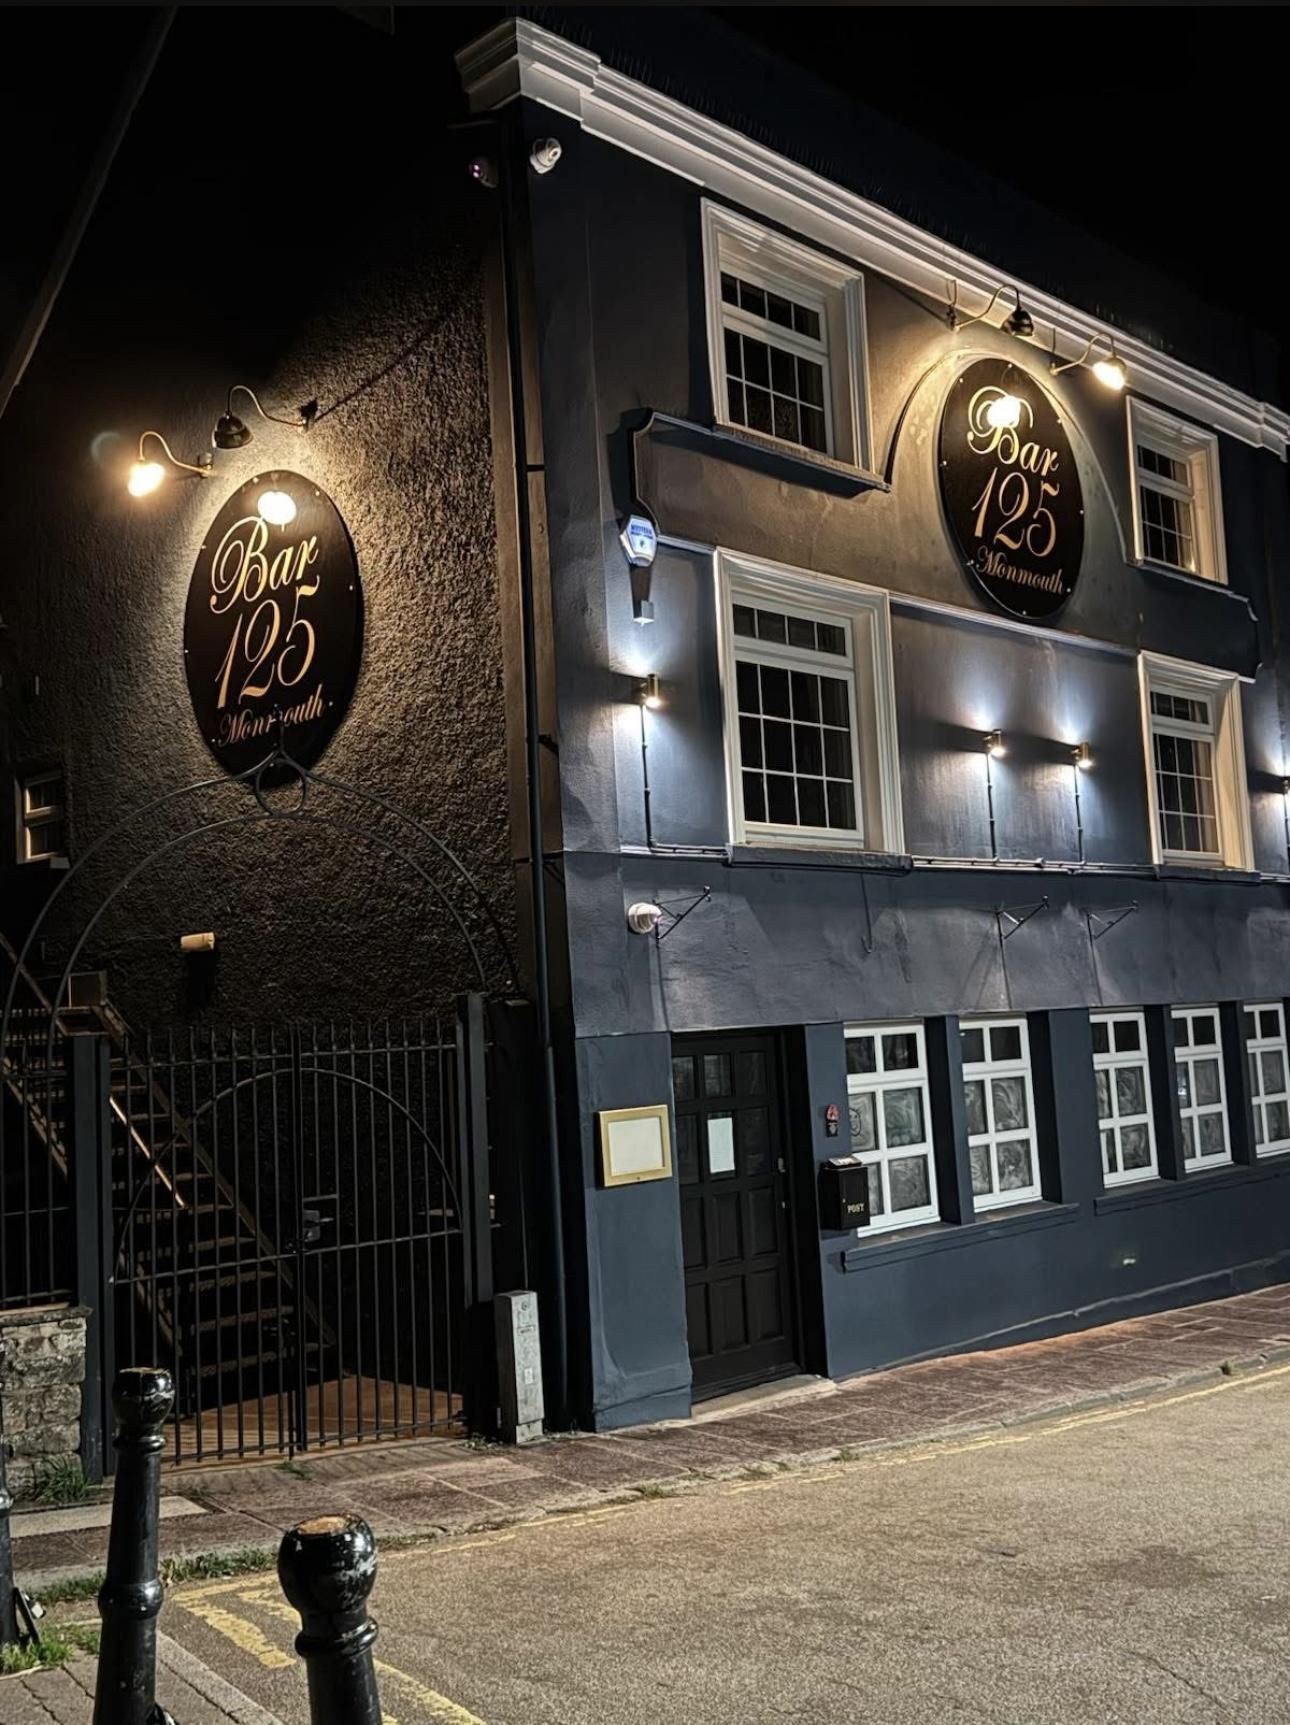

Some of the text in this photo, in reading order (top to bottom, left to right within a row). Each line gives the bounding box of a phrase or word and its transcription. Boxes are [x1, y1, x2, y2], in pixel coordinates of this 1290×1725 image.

[967, 385, 1060, 477] Bar
[971, 466, 1060, 557] 125
[210, 515, 320, 614] Bar
[975, 545, 1064, 595] Monmouth
[214, 575, 321, 709] 125
[847, 1203, 865, 1214] POST
